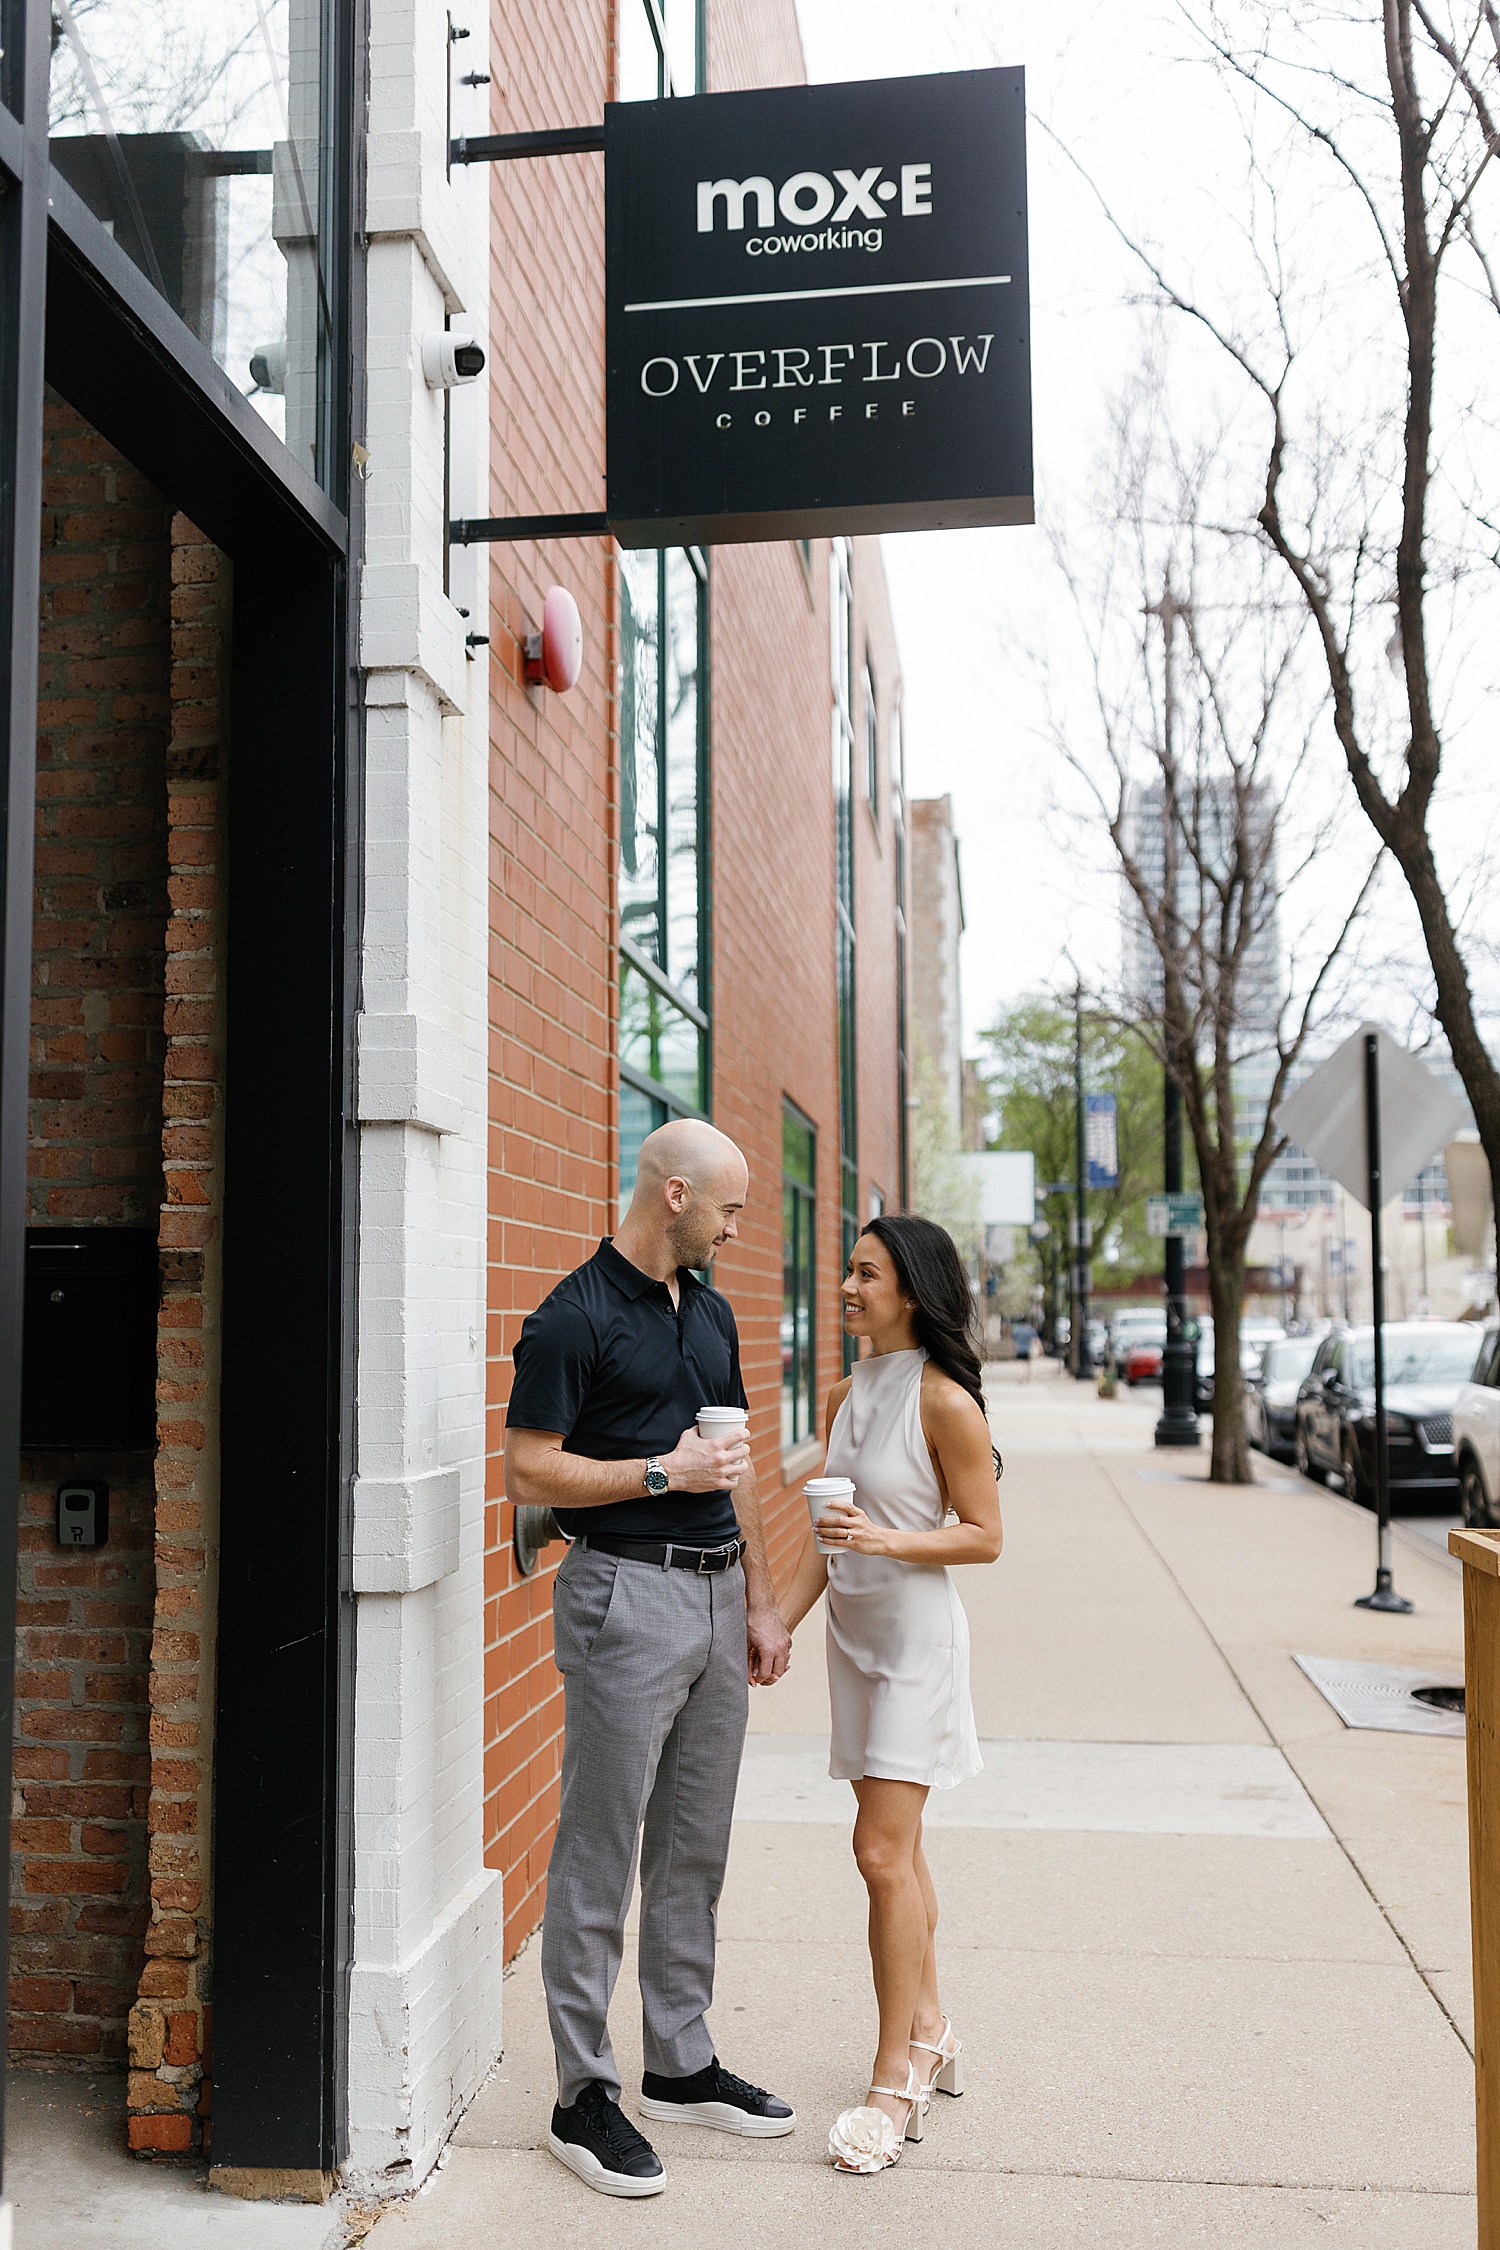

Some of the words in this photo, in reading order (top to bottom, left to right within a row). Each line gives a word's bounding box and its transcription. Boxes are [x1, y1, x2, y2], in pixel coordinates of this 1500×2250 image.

[745, 225, 883, 257] coworking
[640, 334, 995, 397] OVERFLOW
[716, 400, 916, 429] COFFEE
